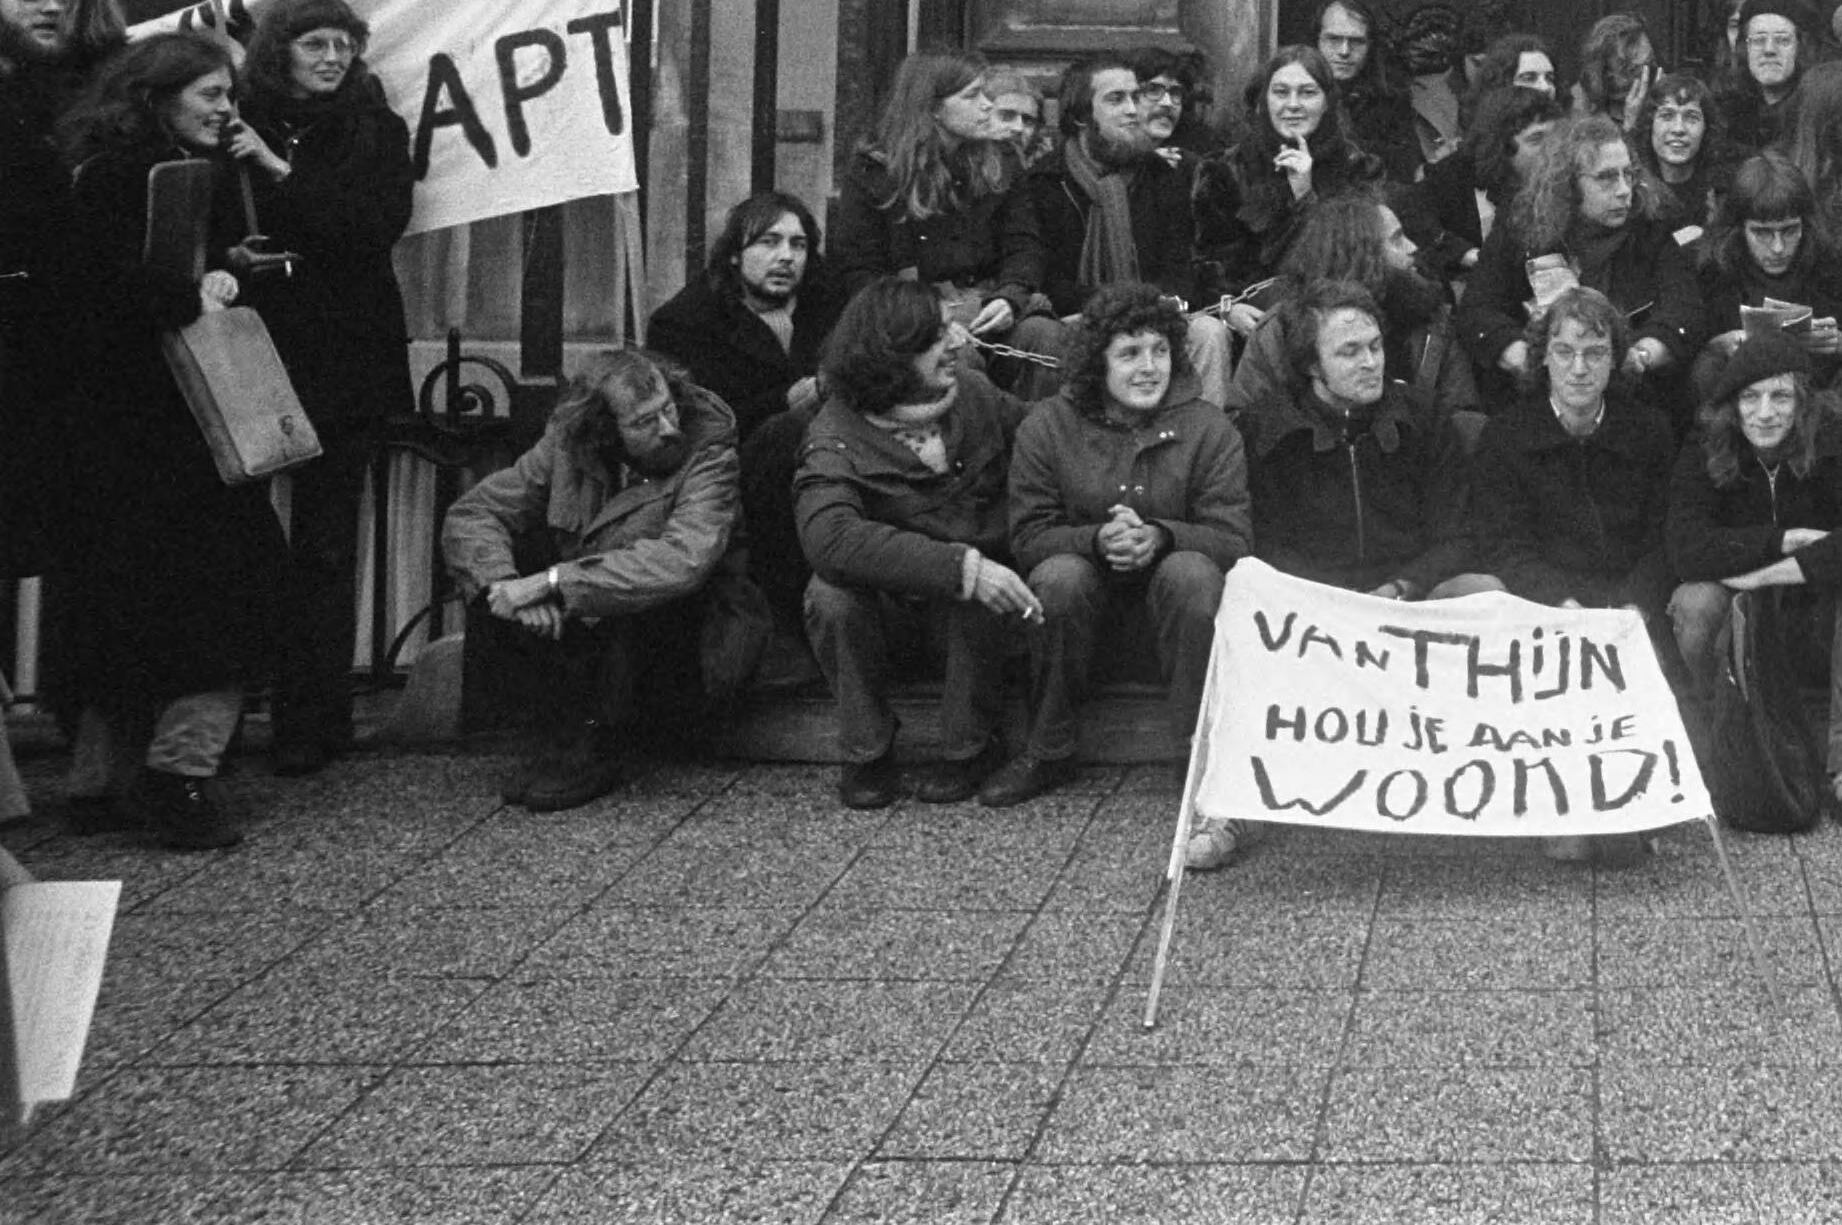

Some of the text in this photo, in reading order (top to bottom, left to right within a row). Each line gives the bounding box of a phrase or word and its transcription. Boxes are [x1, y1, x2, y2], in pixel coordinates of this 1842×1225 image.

[1253, 610, 1390, 671] VAN
[1265, 704, 1389, 746] HOU
[1466, 722, 1572, 752] AAN
